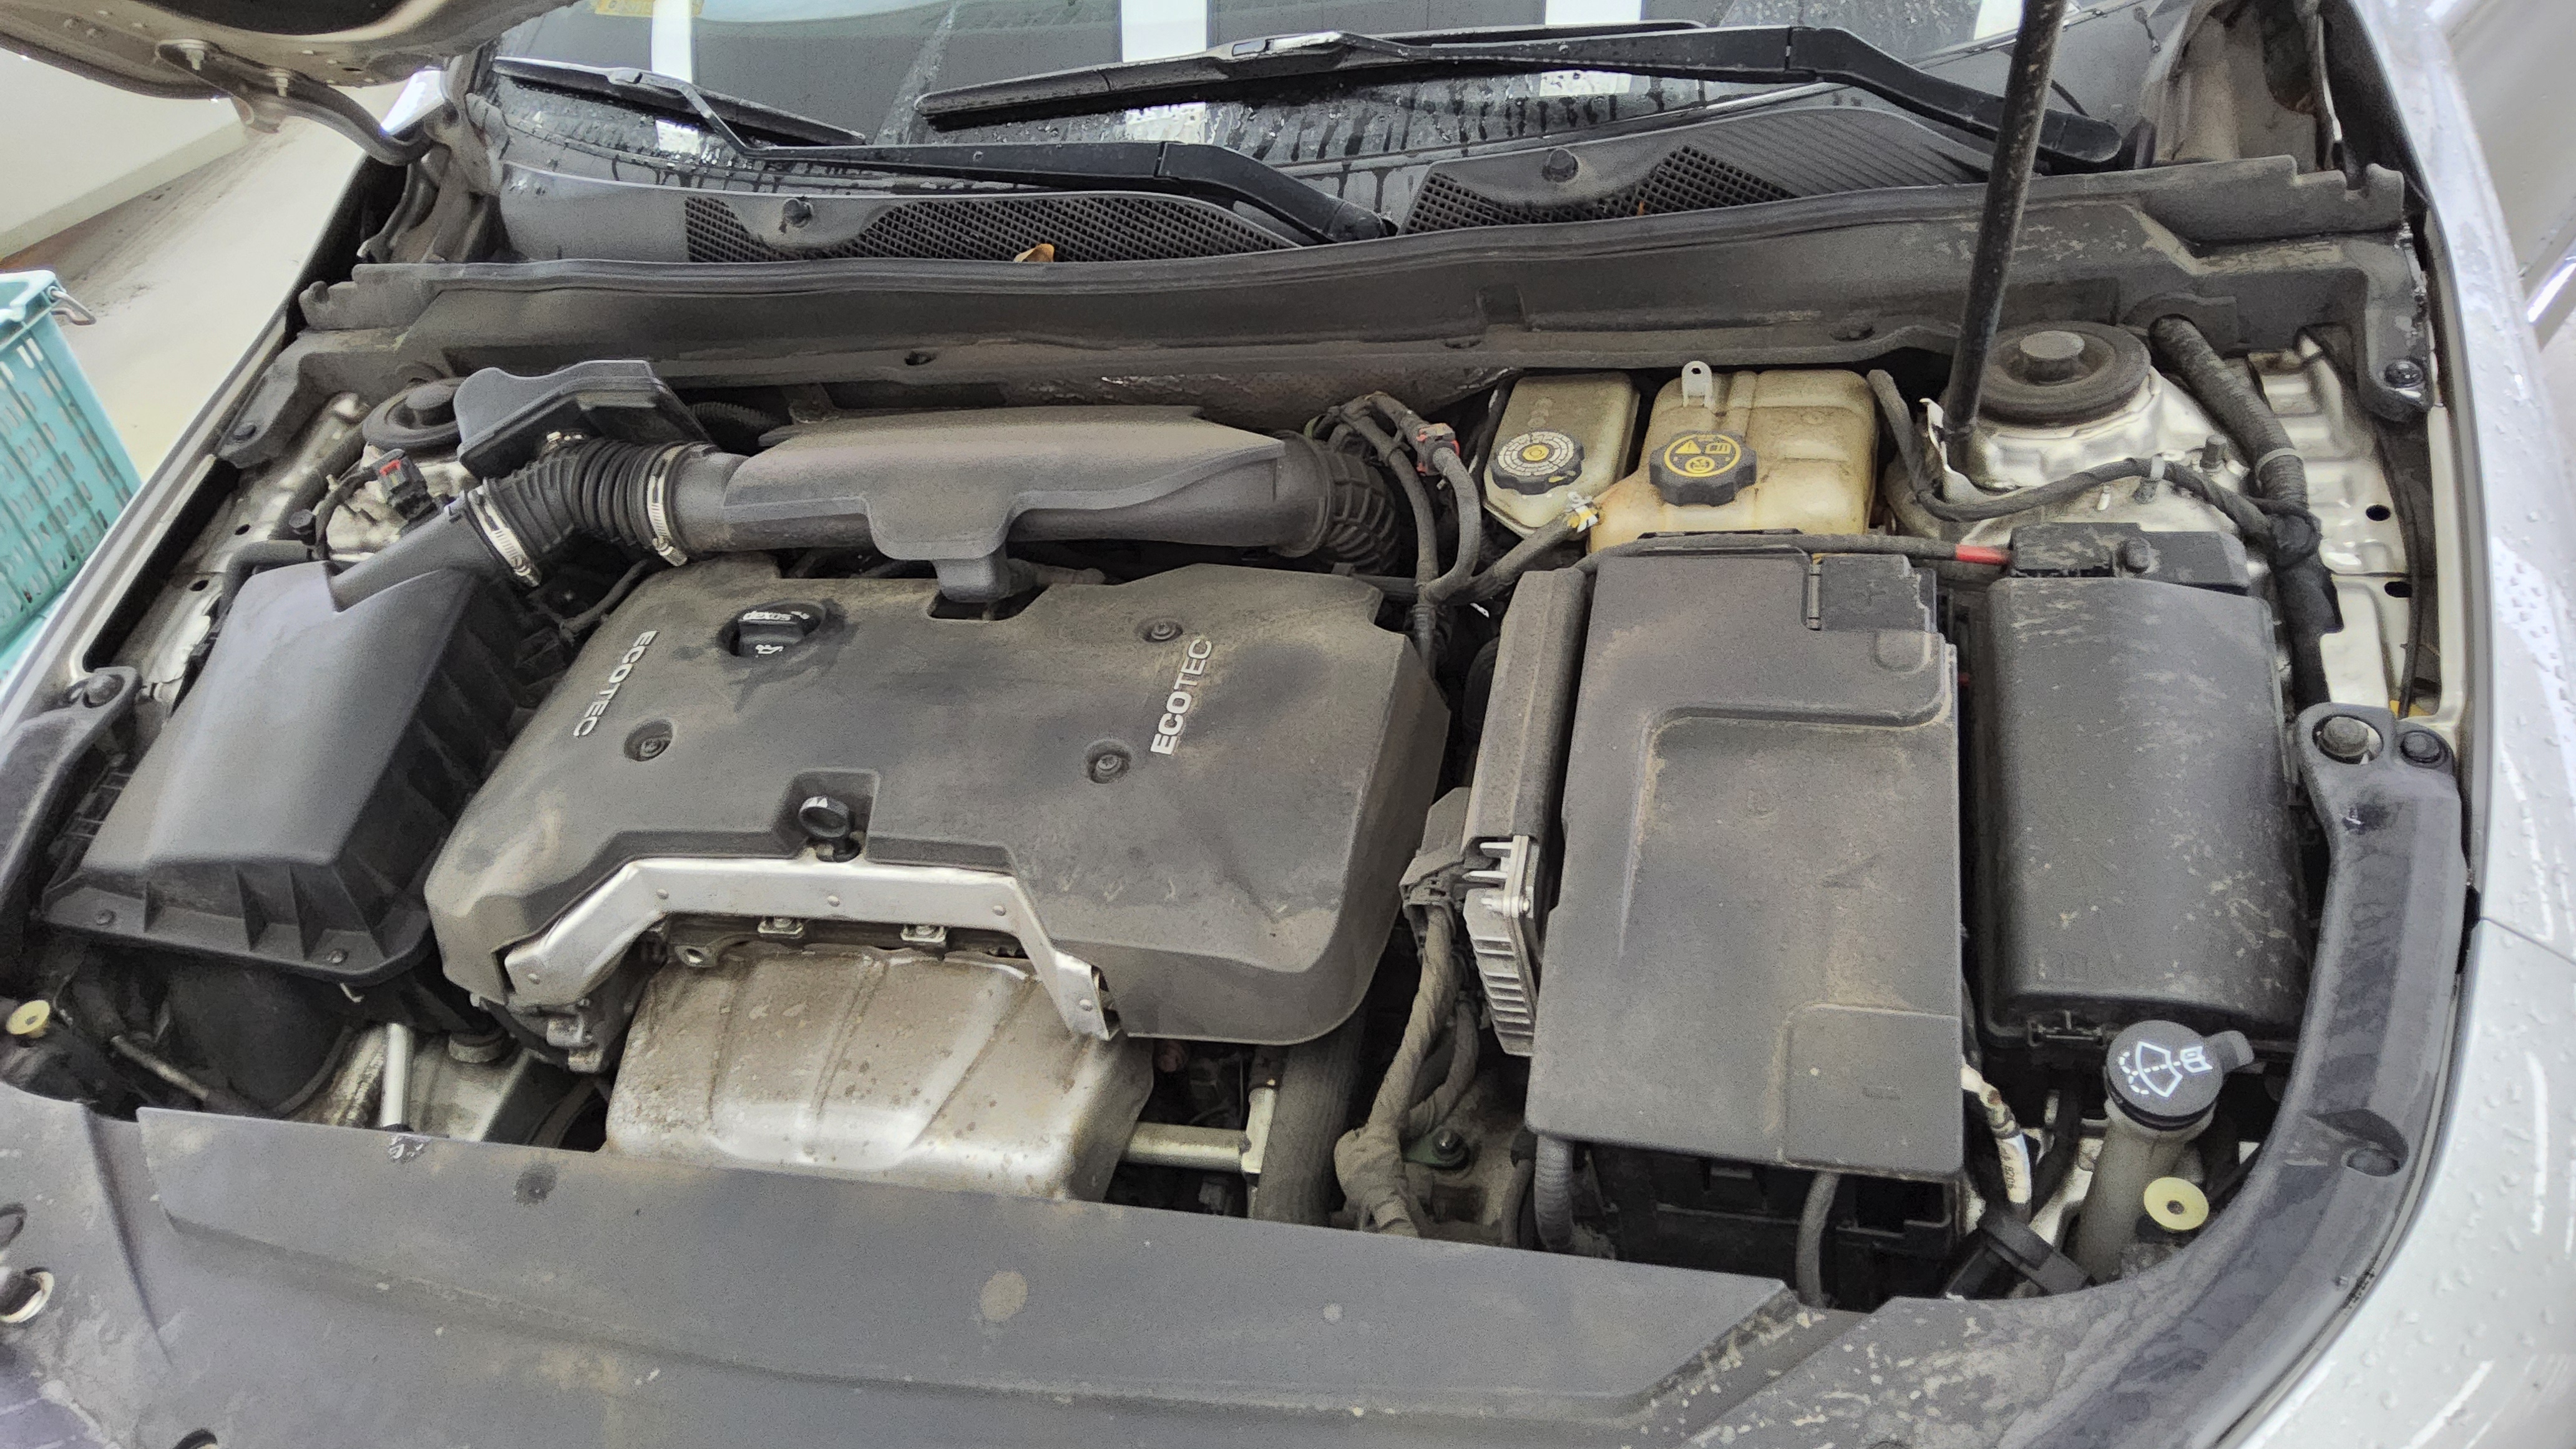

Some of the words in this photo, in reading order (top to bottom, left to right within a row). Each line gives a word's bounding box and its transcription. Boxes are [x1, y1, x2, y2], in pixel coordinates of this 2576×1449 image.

[743, 610, 793, 621] dexos
[573, 630, 658, 736] ECOTEC
[1150, 638, 1212, 755] ECOTEC
